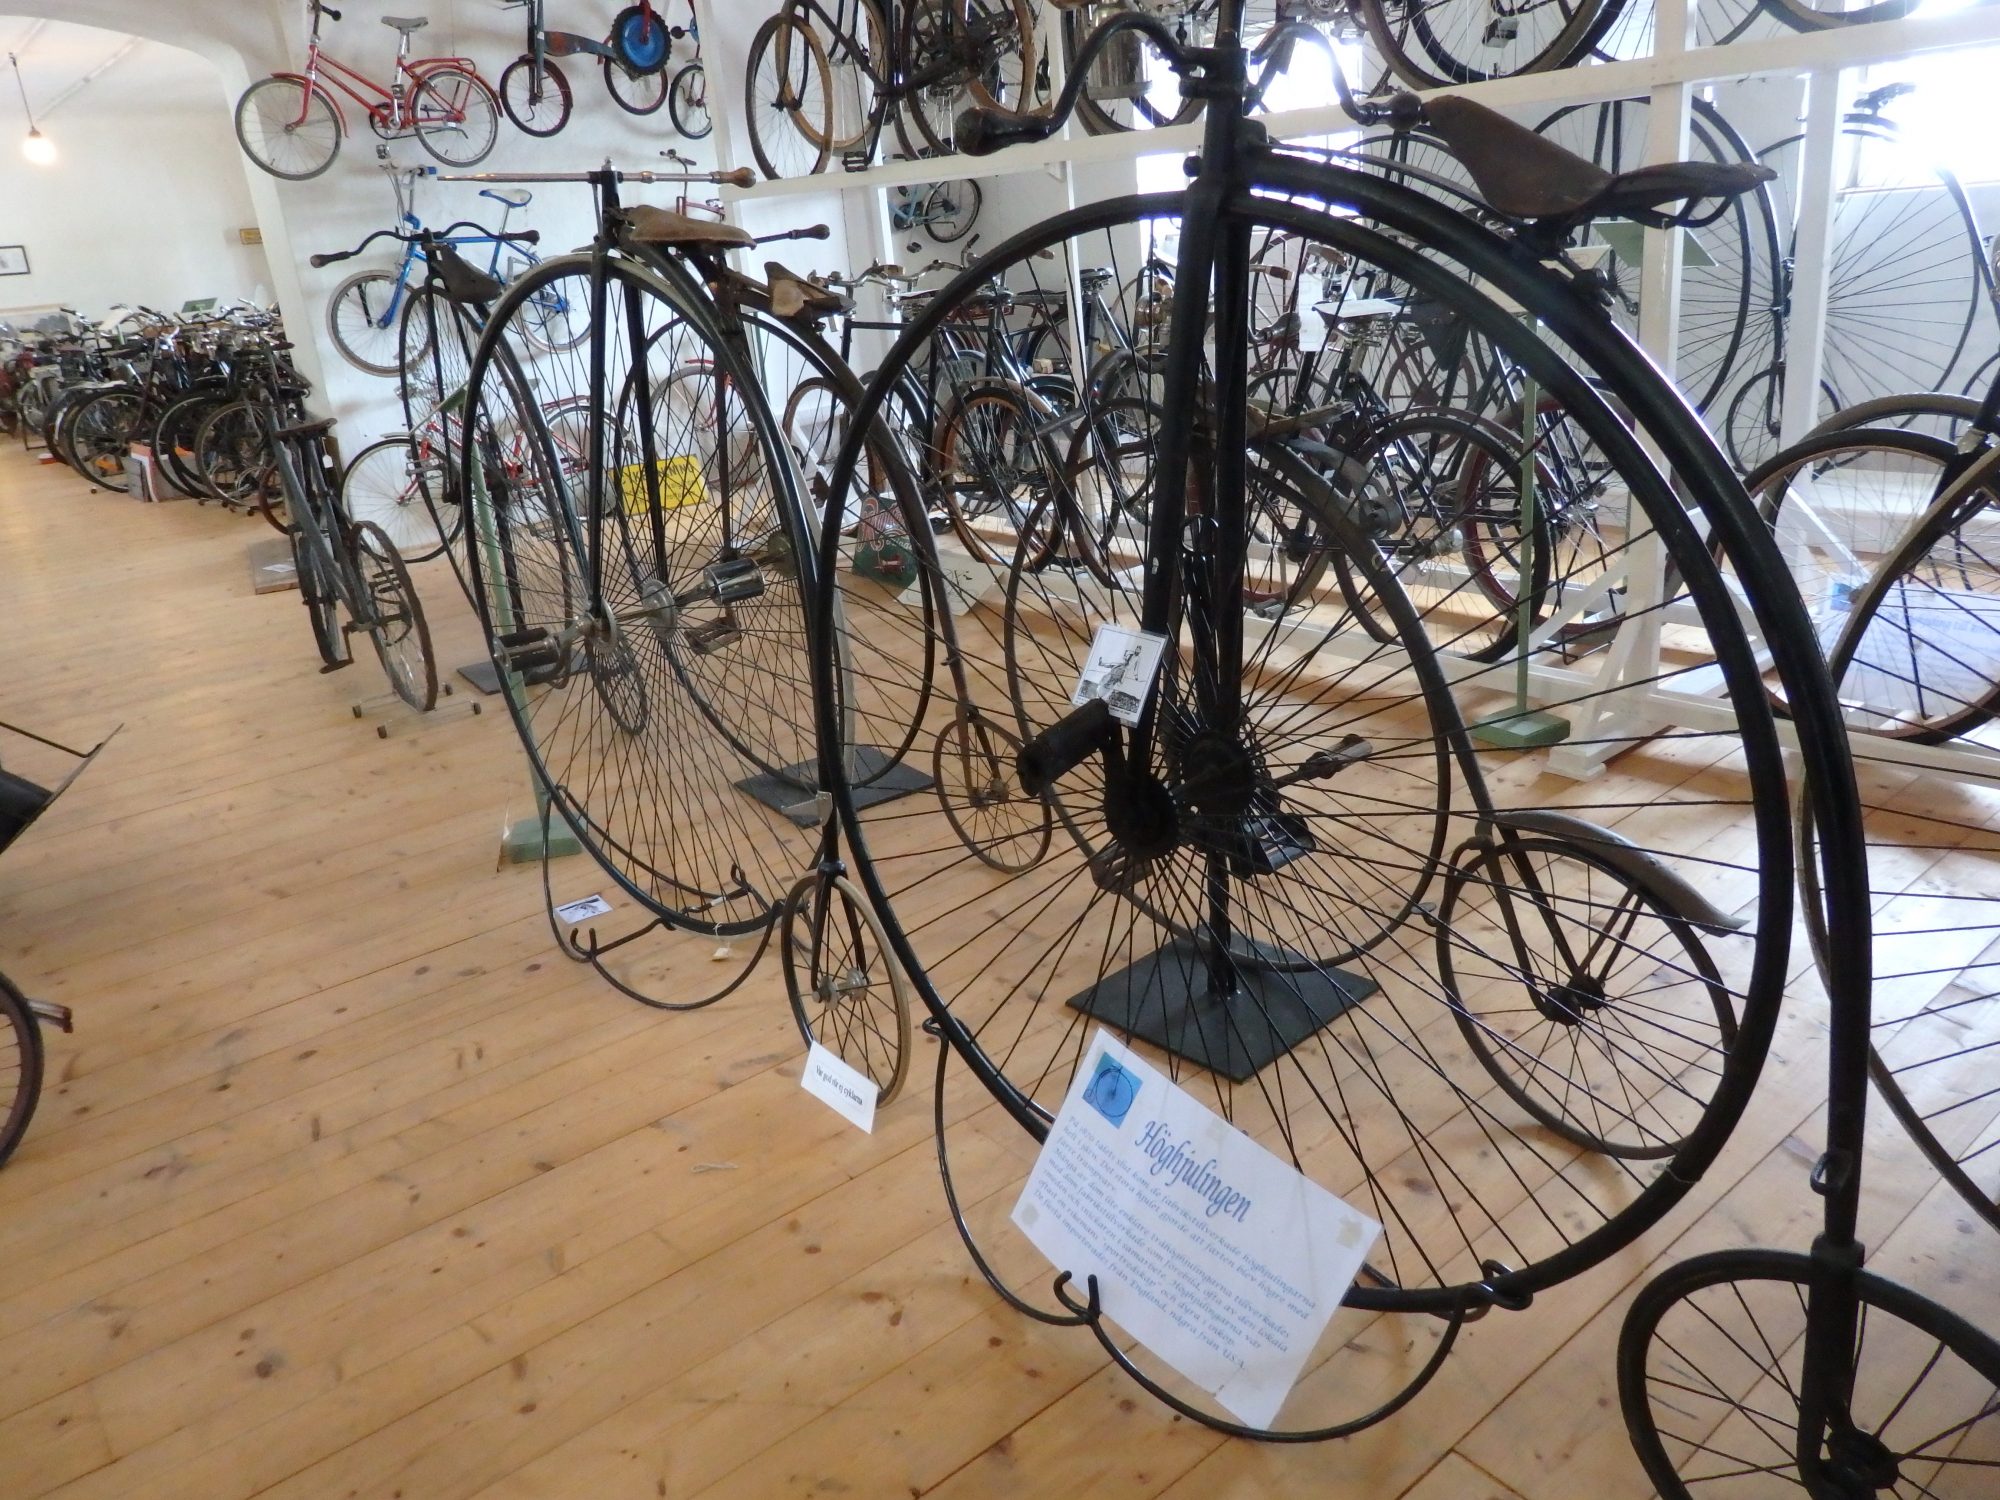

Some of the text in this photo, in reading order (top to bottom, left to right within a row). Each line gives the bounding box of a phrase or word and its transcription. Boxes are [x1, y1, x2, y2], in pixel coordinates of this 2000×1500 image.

[1134, 1120, 1251, 1223] Höghjulingen
[1099, 1160, 1114, 1174] Det
[1115, 1174, 1135, 1192] stora
[1135, 1190, 1159, 1212] hjulet
[1158, 1213, 1188, 1232] gjorde
[1189, 1234, 1204, 1244] att
[1205, 1243, 1234, 1267] farten
[1236, 1265, 1256, 1281] blev
[1257, 1281, 1285, 1302] högre
[1287, 1303, 1309, 1319] med
[1116, 1159, 1131, 1172] slut
[1132, 1171, 1149, 1188] kom
[1150, 1187, 1161, 1196] de
[1162, 1196, 1240, 1254] fabrikstillverkade
[1242, 1254, 1315, 1308] höghjulingarna
[1118, 1209, 1148, 1234] enklare
[1234, 1295, 1288, 1337] tillverkades
[1223, 1305, 1234, 1314] av
[1237, 1316, 1255, 1329] den
[1257, 1328, 1287, 1352] lokala
[1245, 1334, 1261, 1348] var
